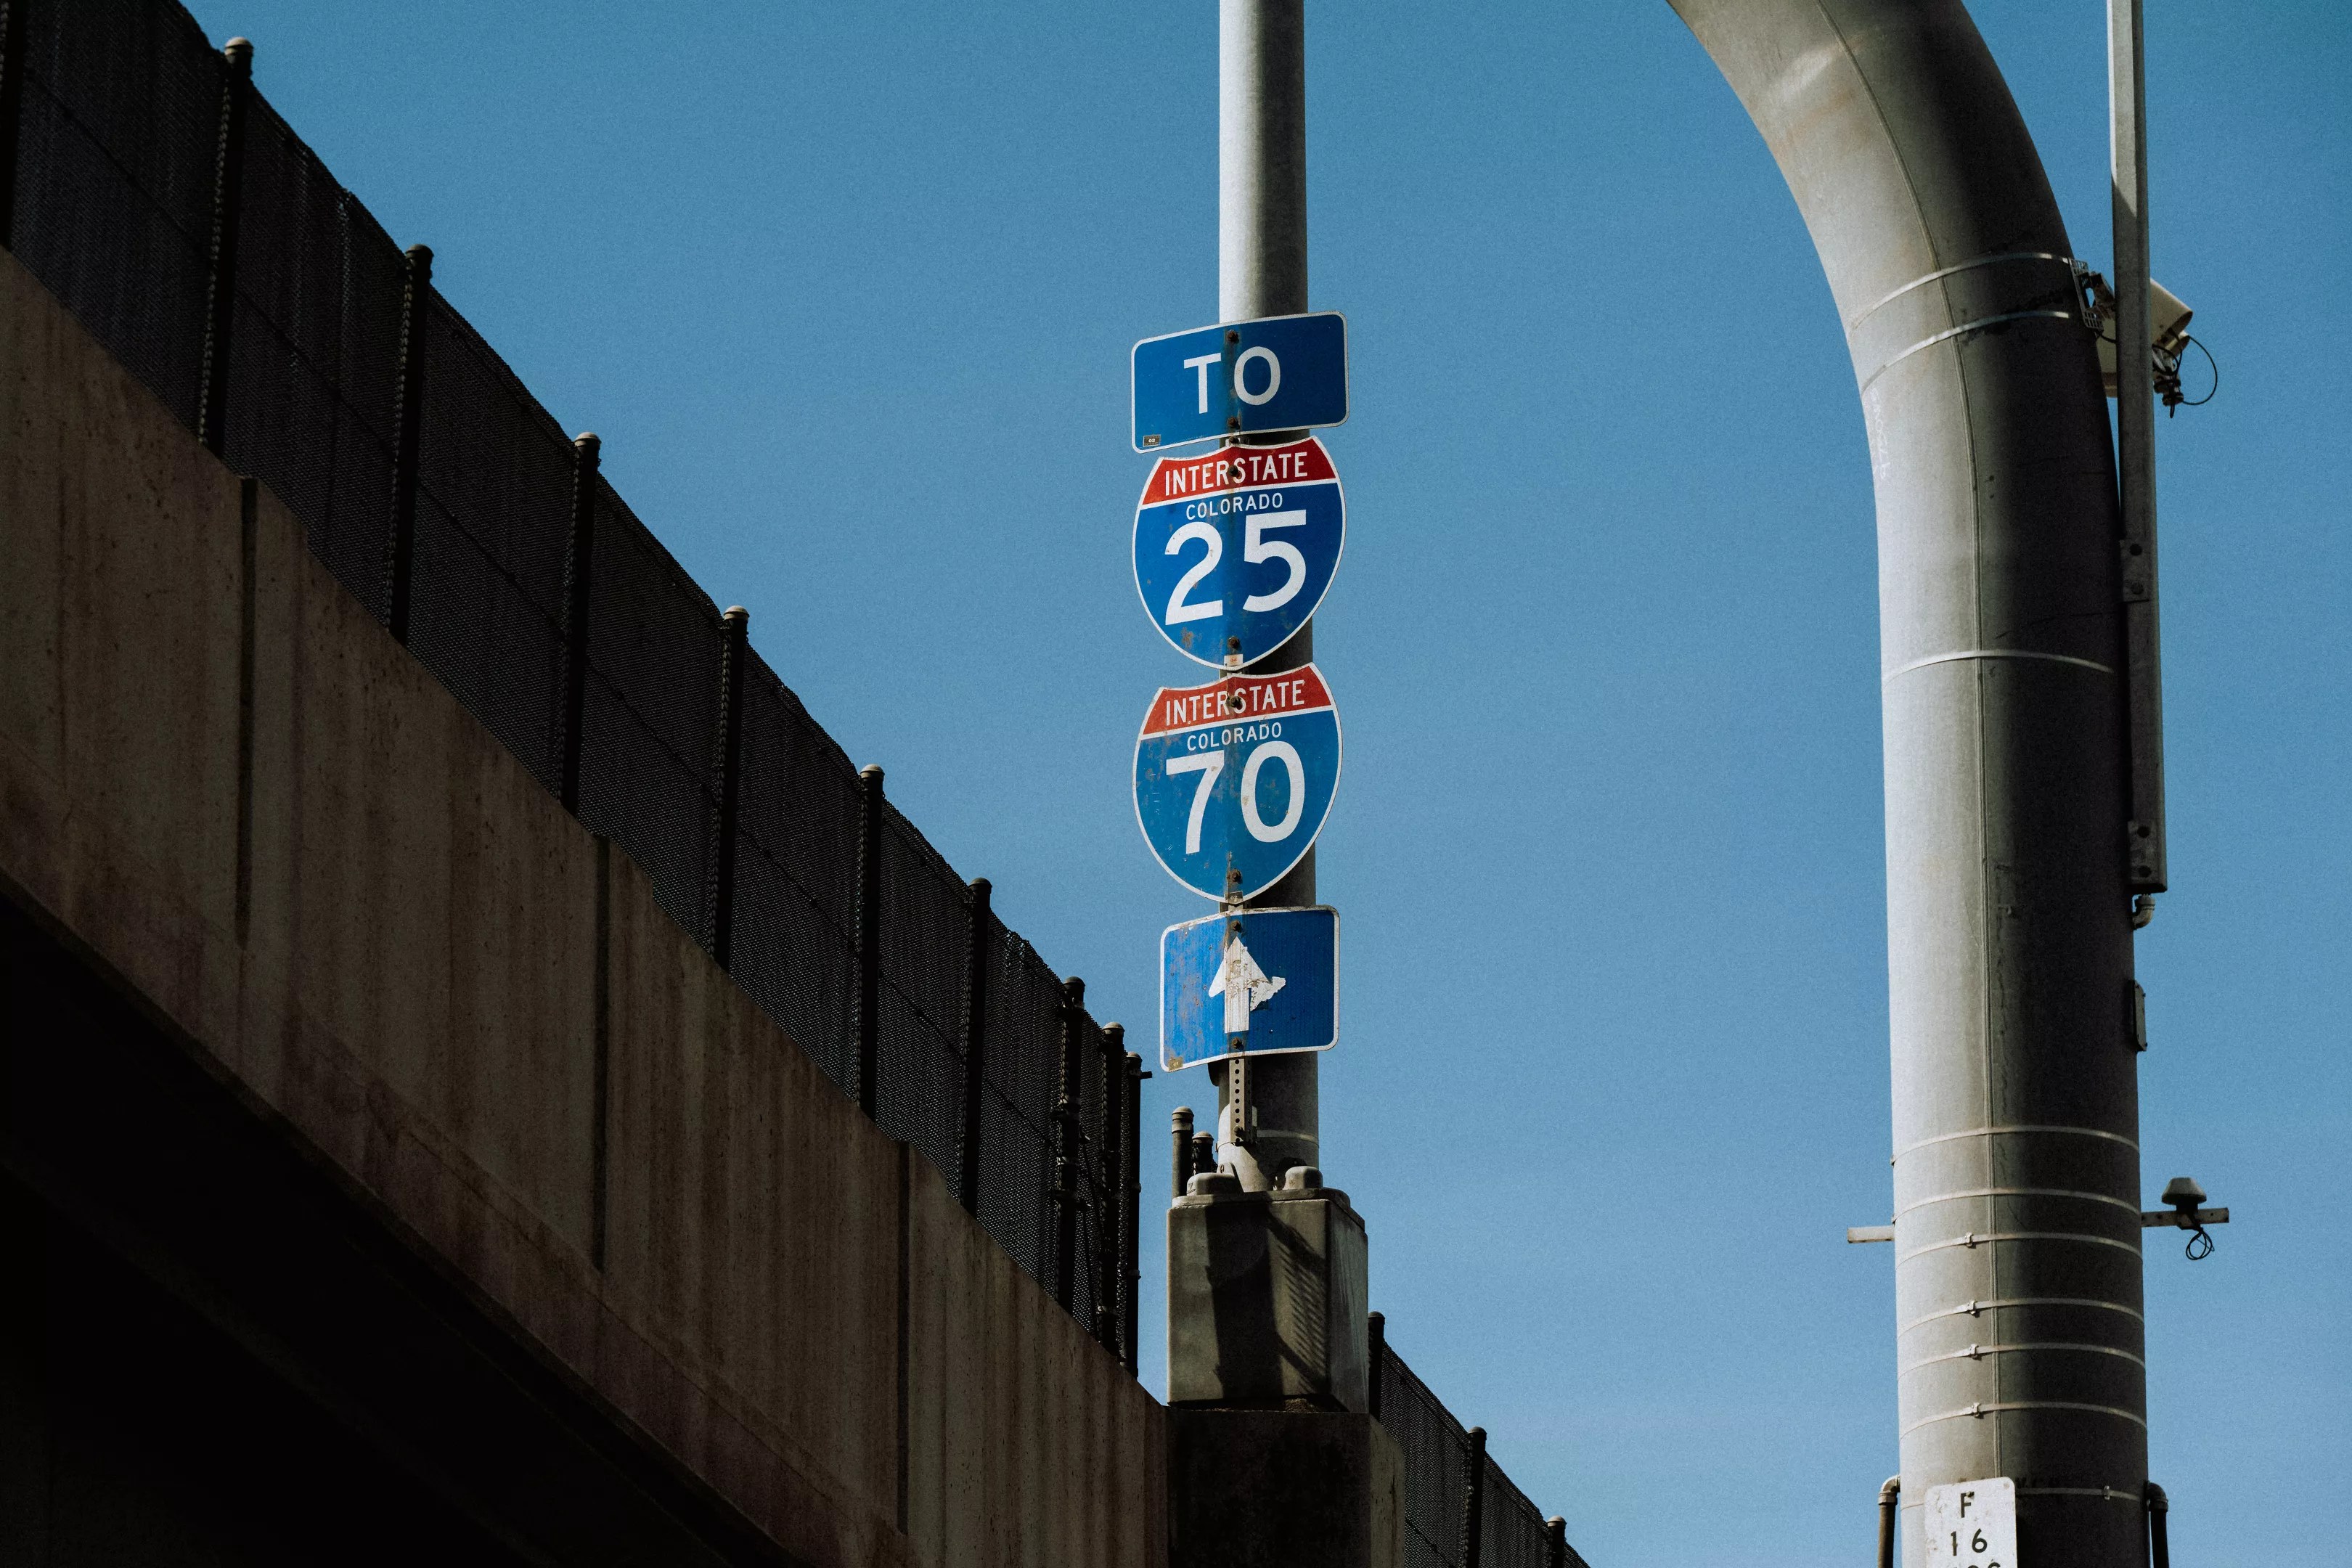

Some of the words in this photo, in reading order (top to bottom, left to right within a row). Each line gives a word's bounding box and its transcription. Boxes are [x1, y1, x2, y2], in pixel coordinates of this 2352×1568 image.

[1184, 346, 1281, 414] TO
[1165, 452, 1307, 496] INTERSTATE
[1186, 493, 1283, 520] COLORADO
[1164, 510, 1307, 625] 25
[1166, 679, 1305, 726] INTERSTATE
[1187, 722, 1282, 751] COLORADO
[1166, 740, 1305, 854] 70
[1961, 1492, 1975, 1518] F
[1951, 1528, 1988, 1556] 16
